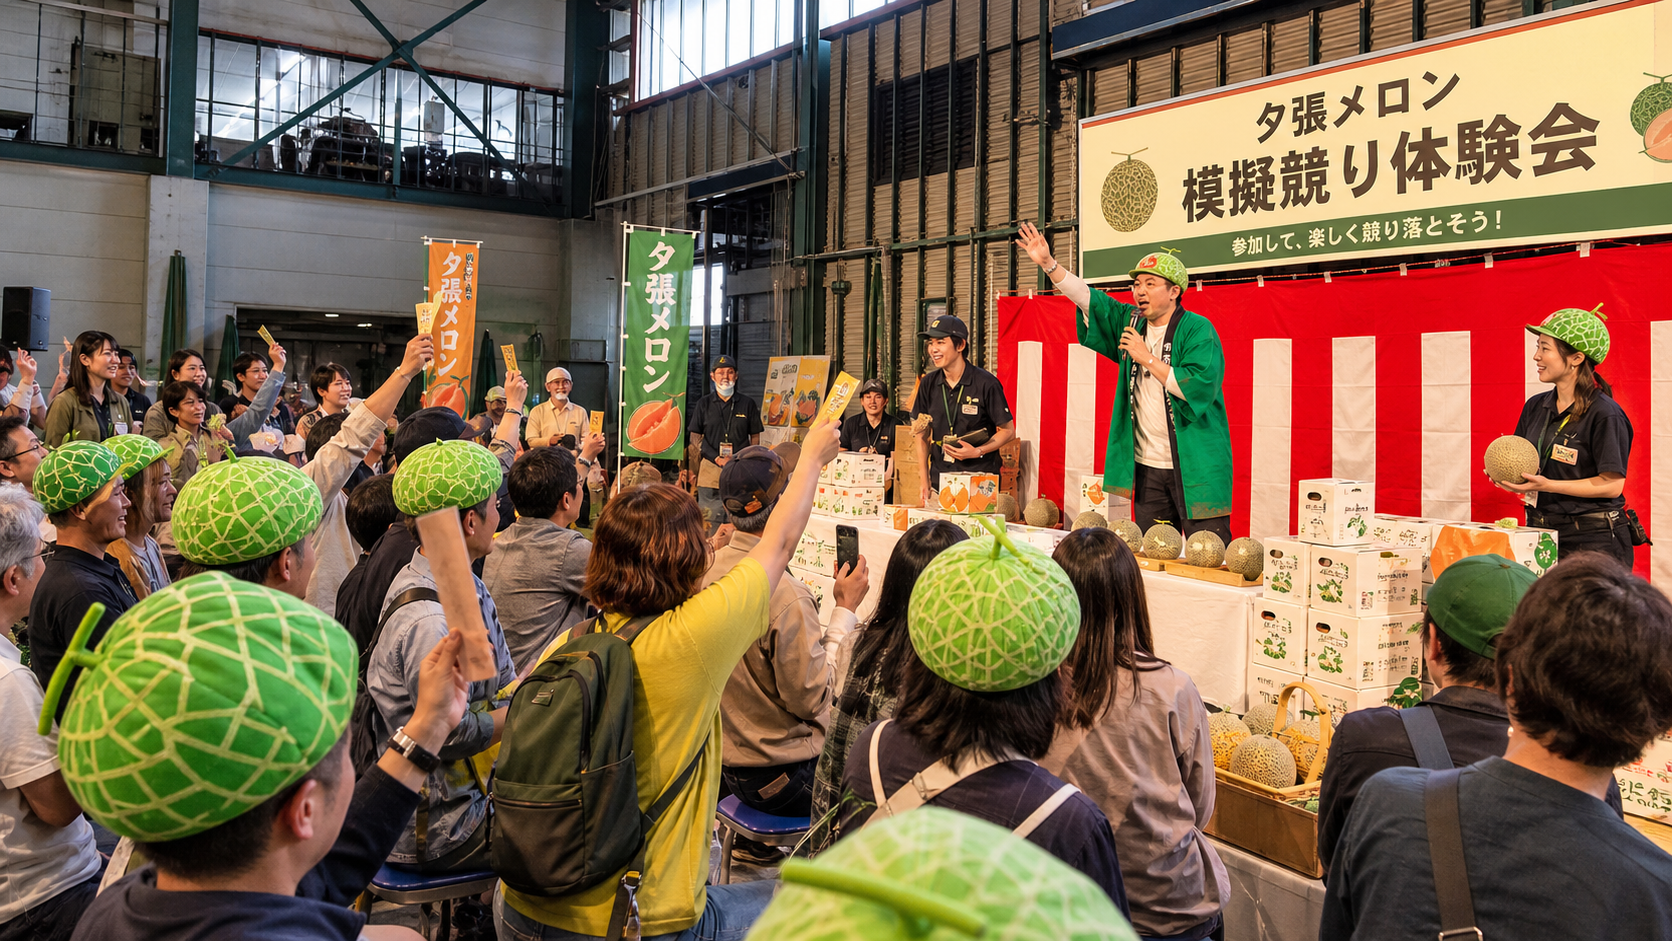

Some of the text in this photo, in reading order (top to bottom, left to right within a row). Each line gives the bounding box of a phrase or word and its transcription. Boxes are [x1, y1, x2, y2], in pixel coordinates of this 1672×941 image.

[1182, 102, 1601, 223] 模擬競り体験会
[1256, 70, 1461, 144] 夕張メロン
[1231, 210, 1502, 257] 参加して、楽しく競り落とそう！
[437, 251, 463, 376] 夕張メロン
[643, 241, 677, 393] 夕張メロン
